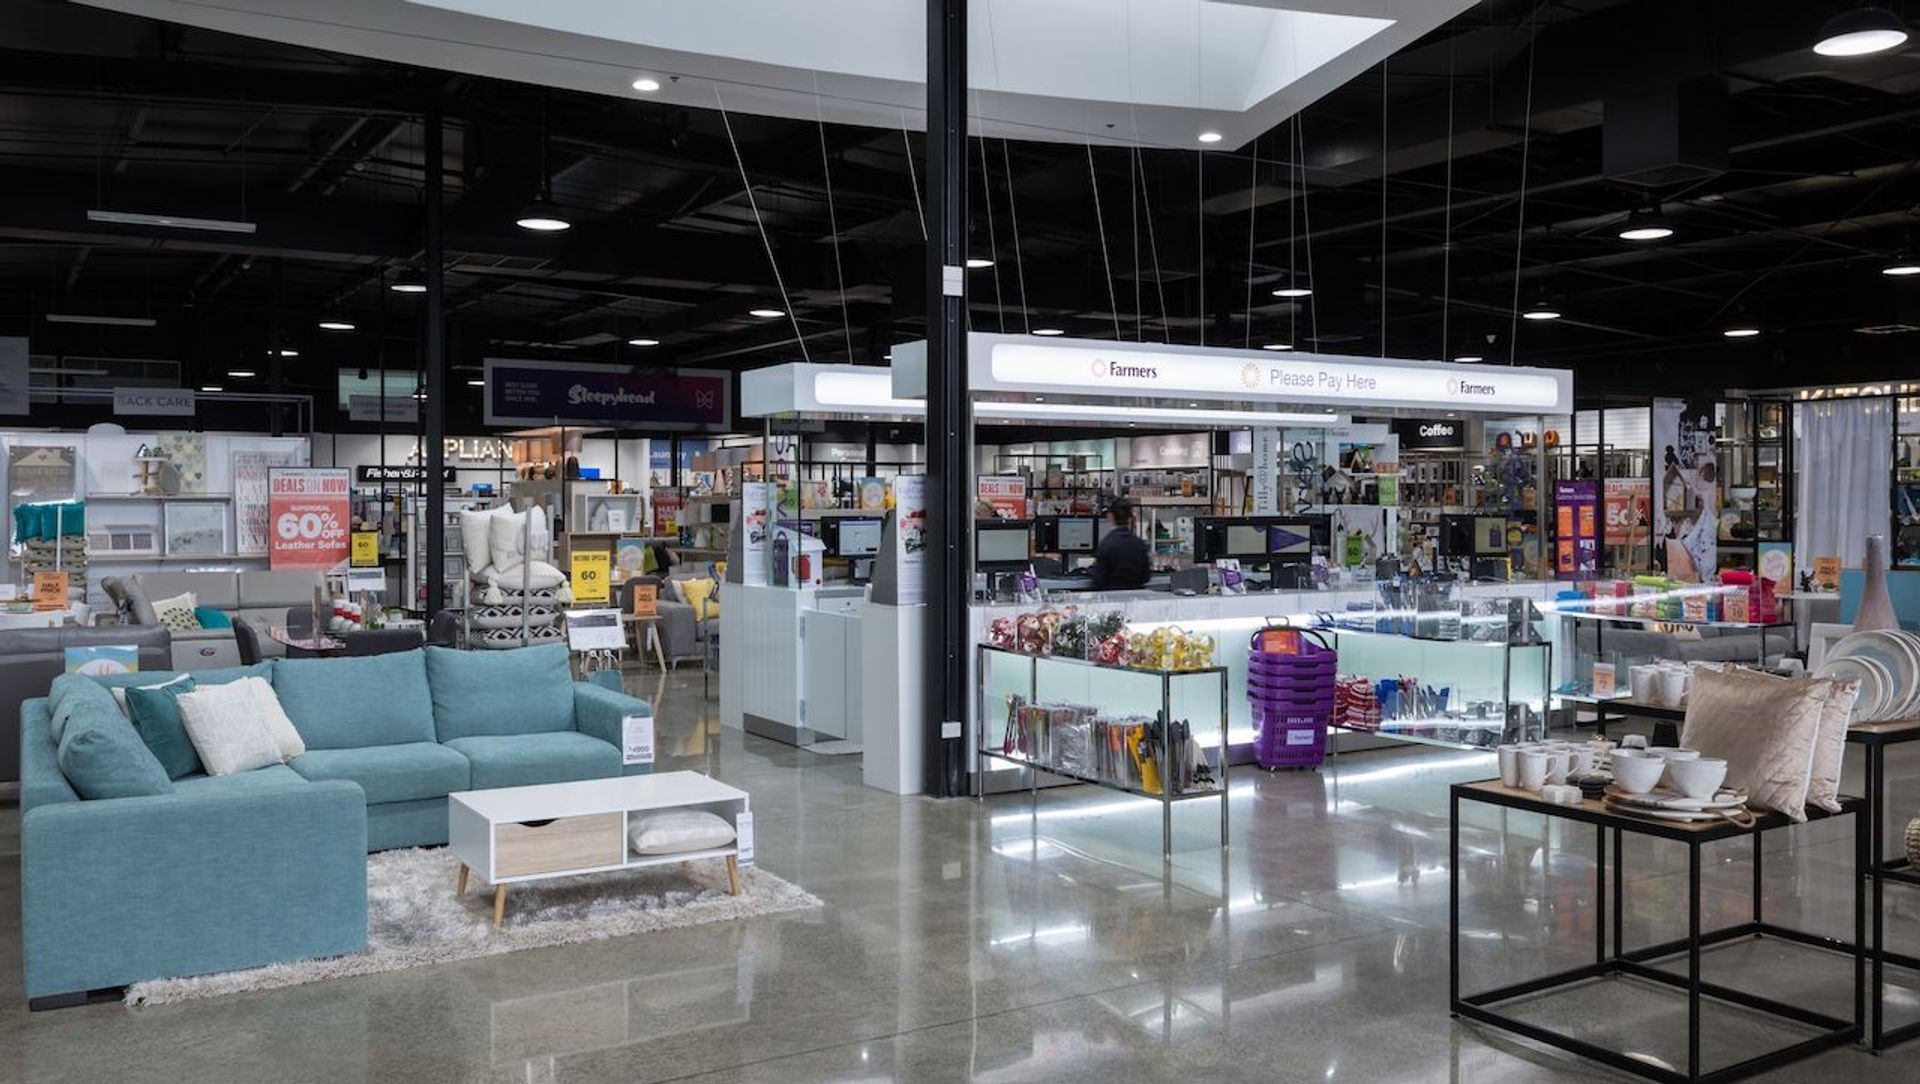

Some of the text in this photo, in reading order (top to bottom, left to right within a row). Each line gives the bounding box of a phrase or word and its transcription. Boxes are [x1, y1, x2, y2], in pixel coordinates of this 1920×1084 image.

[1109, 361, 1157, 379] Farmers
[1270, 369, 1377, 390] Please Pay Here
[568, 384, 655, 406] Sleepyhead
[1460, 380, 1496, 395] Farmers
[156, 397, 193, 408] CARE
[1419, 423, 1454, 437] Coffee
[273, 478, 305, 493] DEALS
[322, 479, 347, 493] NOW
[277, 512, 339, 540] 60%
[321, 529, 345, 539] OFF
[274, 540, 347, 550] Leather Sofas
[581, 570, 597, 580] 60
